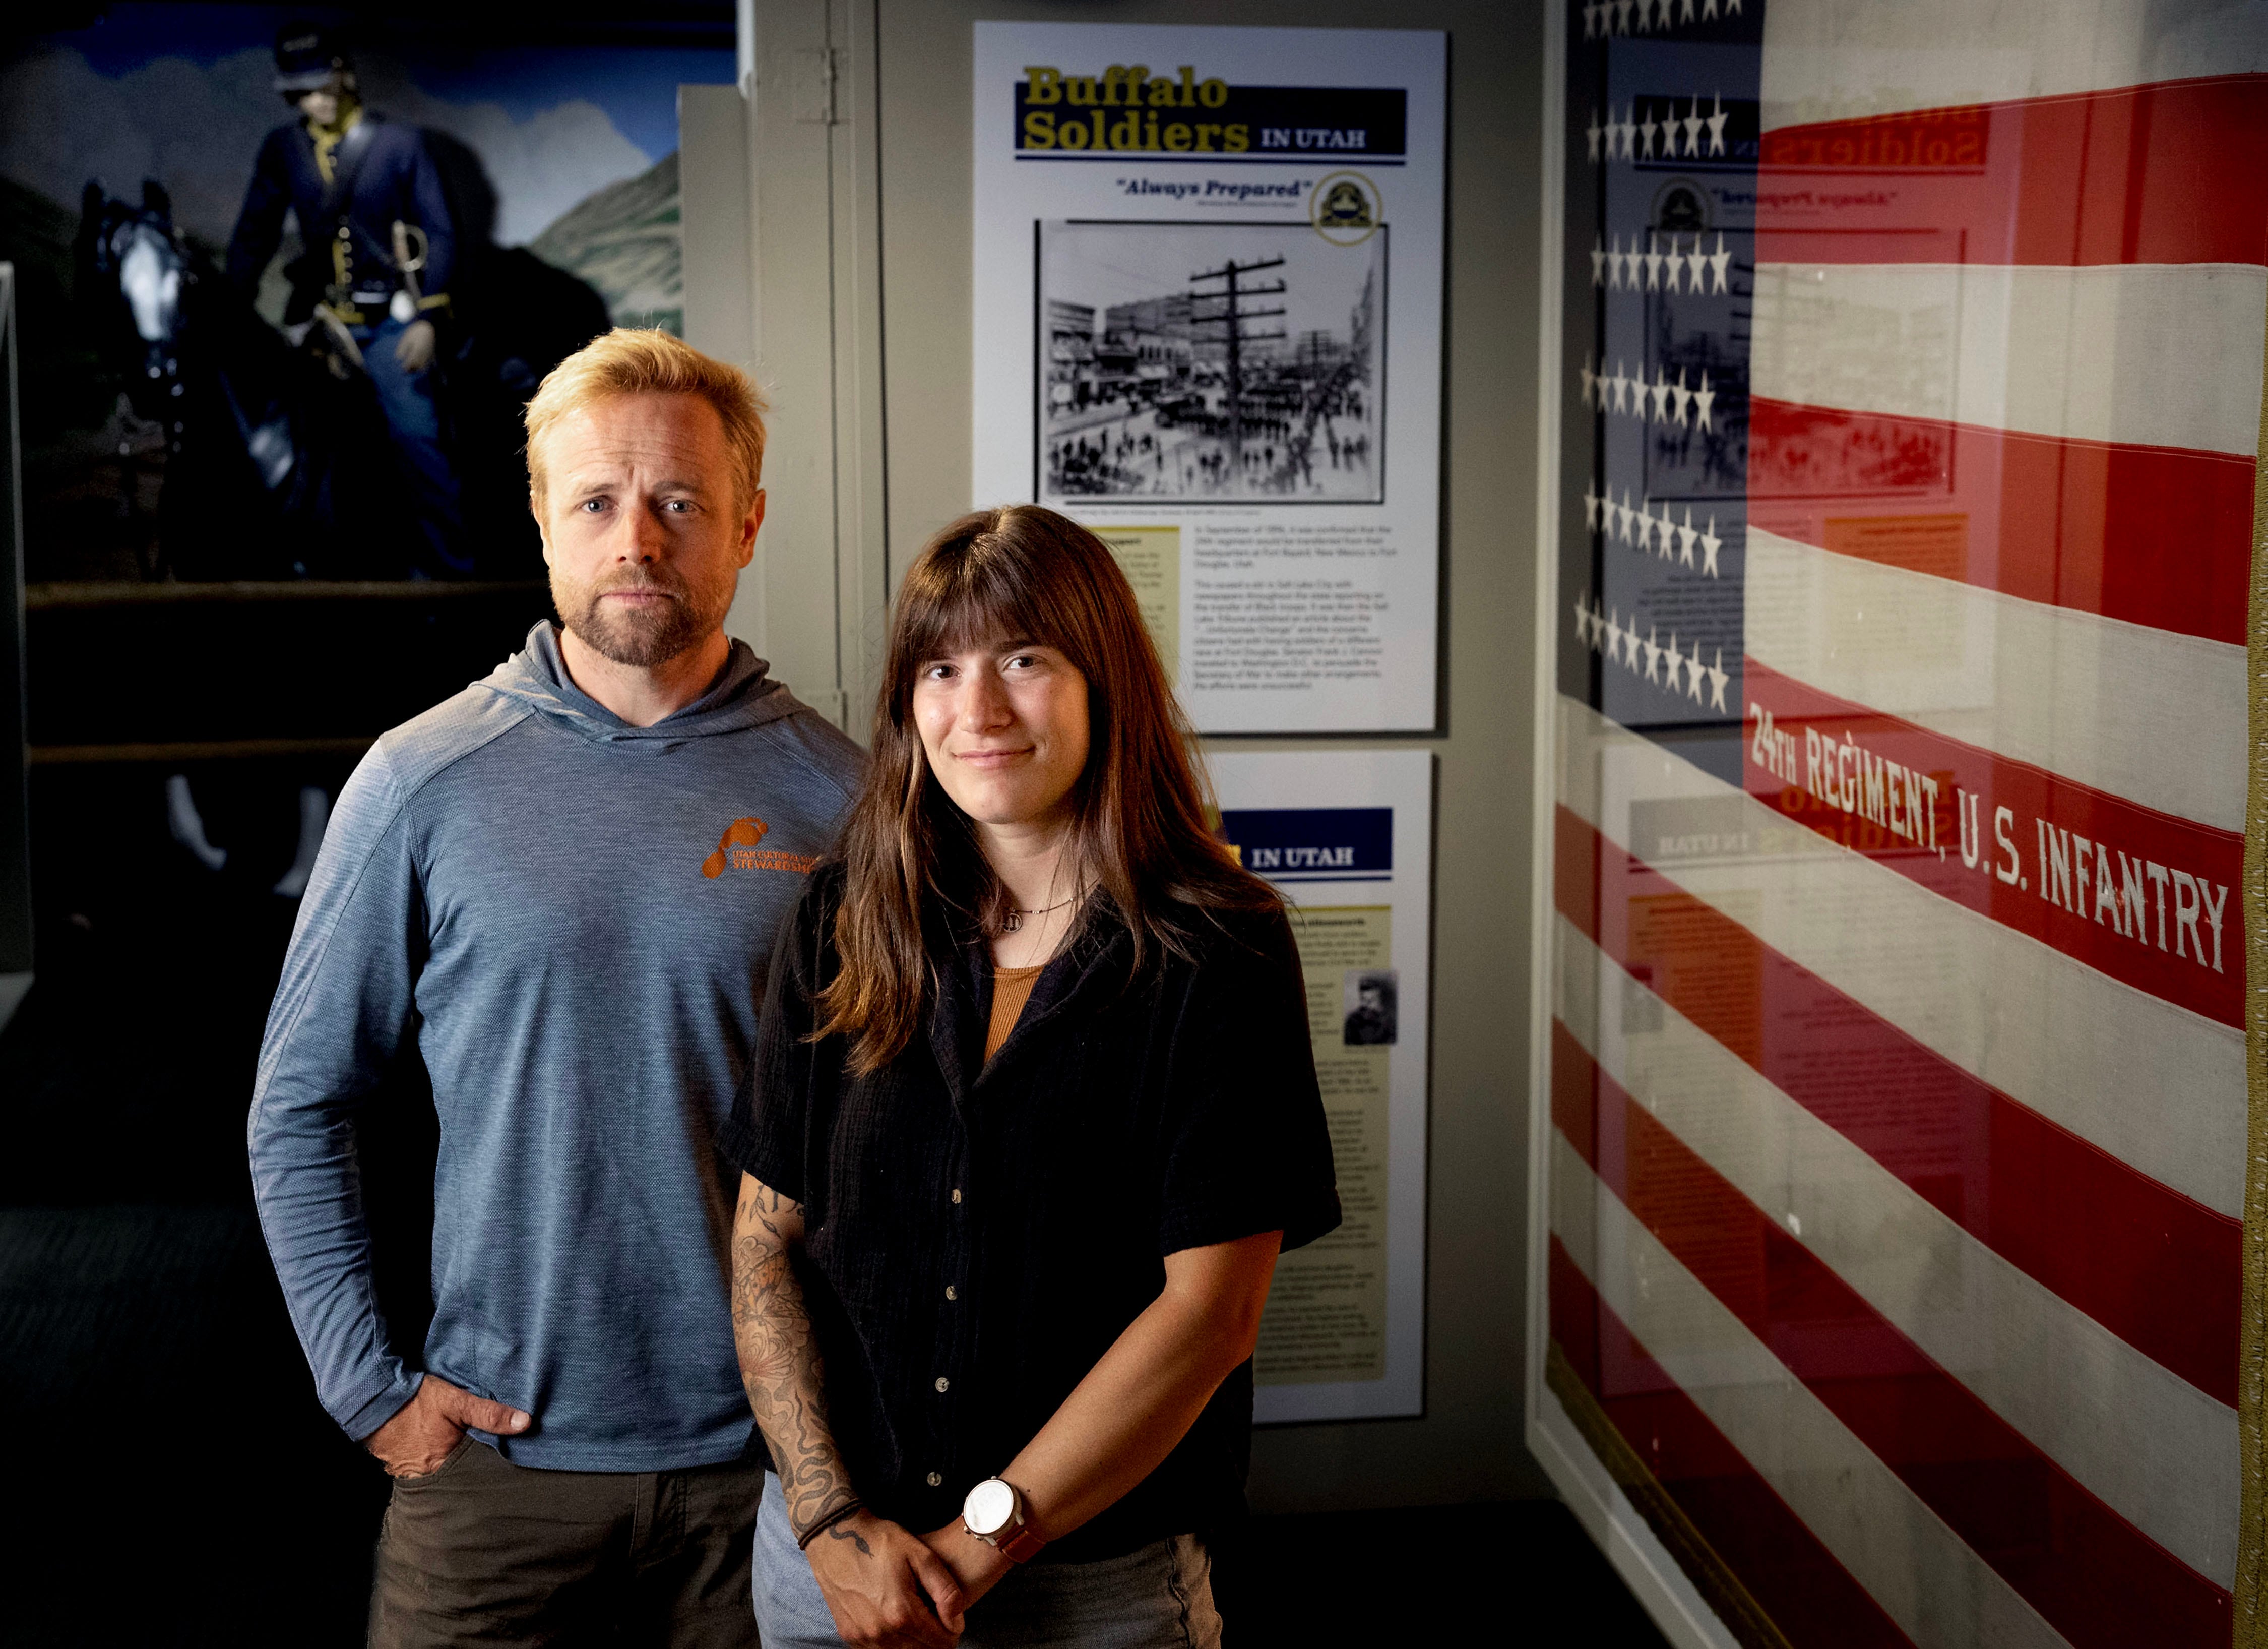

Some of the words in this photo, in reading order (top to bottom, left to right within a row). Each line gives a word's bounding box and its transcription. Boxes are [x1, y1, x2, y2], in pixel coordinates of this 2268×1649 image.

[1024, 65, 1228, 108] Buffalo
[1024, 109, 1250, 152] Soldiers
[1262, 128, 1290, 147] IN
[1295, 128, 1366, 148] UTAH
[1252, 848, 1280, 868] IN
[1284, 847, 1355, 867] UTAH
[1750, 702, 1797, 785] 24TH
[1806, 726, 1946, 863] REGIMENT,
[2036, 818, 2229, 974] INFANTRY
